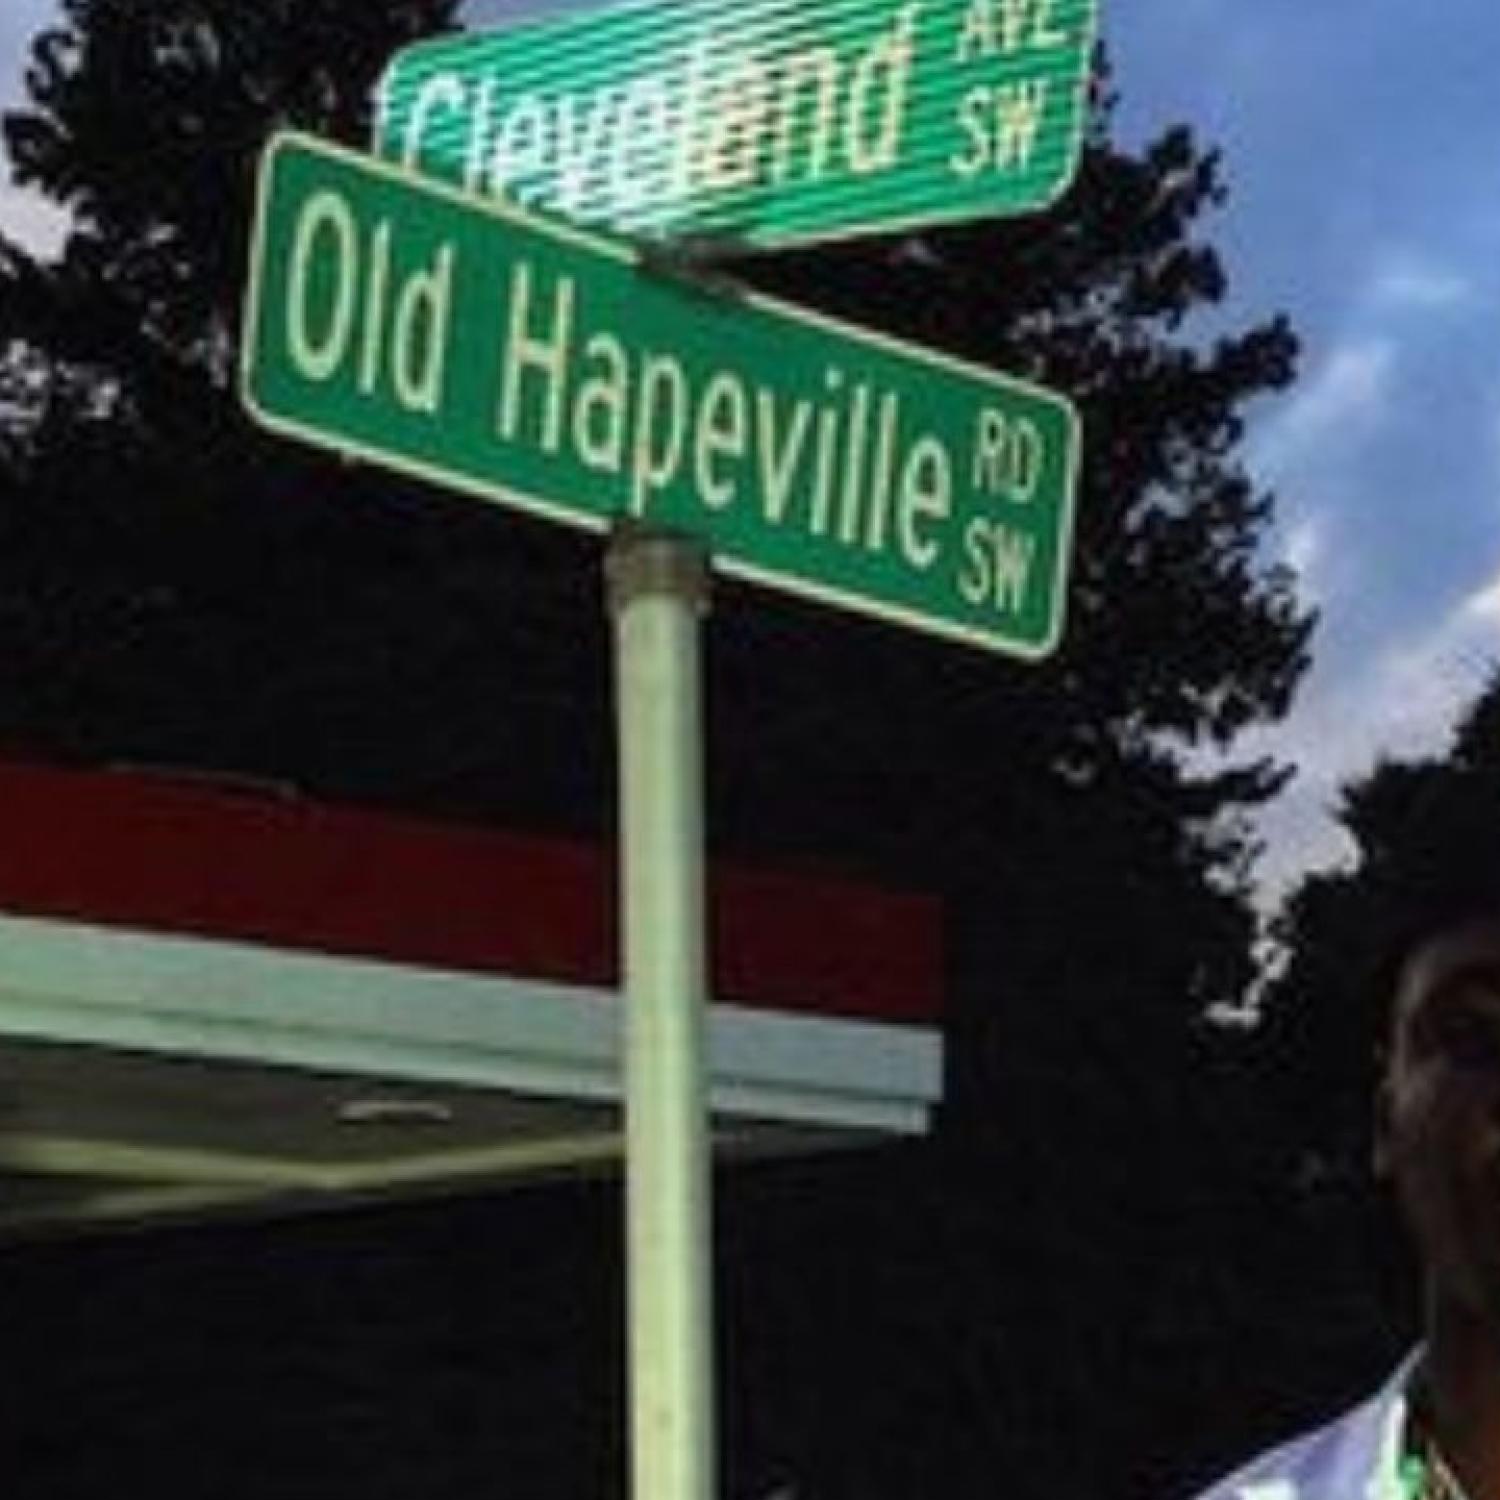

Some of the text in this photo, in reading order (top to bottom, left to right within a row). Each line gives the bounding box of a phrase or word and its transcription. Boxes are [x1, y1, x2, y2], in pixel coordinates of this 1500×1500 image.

[950, 75, 1048, 175] SW
[285, 191, 954, 568] Old Hapeville
[972, 407, 1045, 503] RD
[957, 516, 1037, 615] SW
